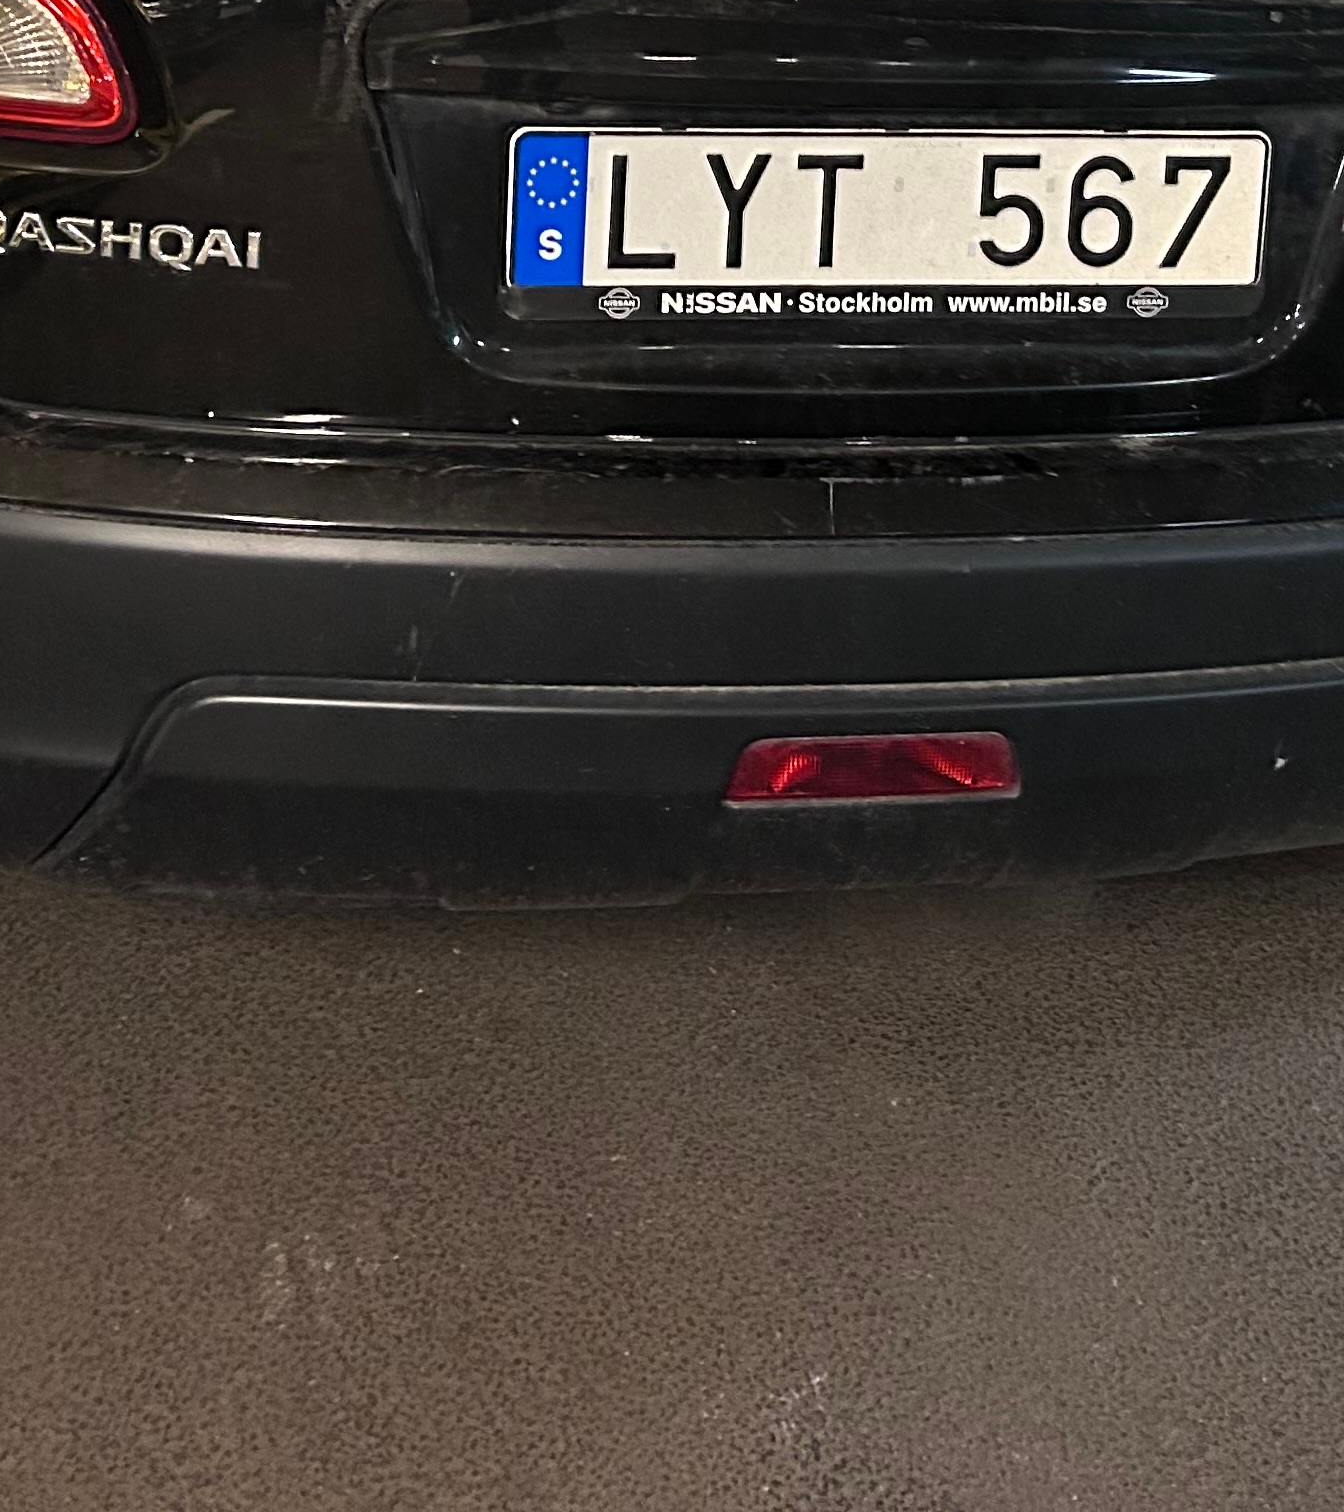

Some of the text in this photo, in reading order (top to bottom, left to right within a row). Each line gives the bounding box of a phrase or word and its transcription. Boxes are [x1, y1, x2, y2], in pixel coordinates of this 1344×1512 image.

[607, 154, 1231, 269] LYT 567
[538, 229, 562, 261] S
[661, 291, 1107, 314] NISSAN Stockholm www.mbil.se
